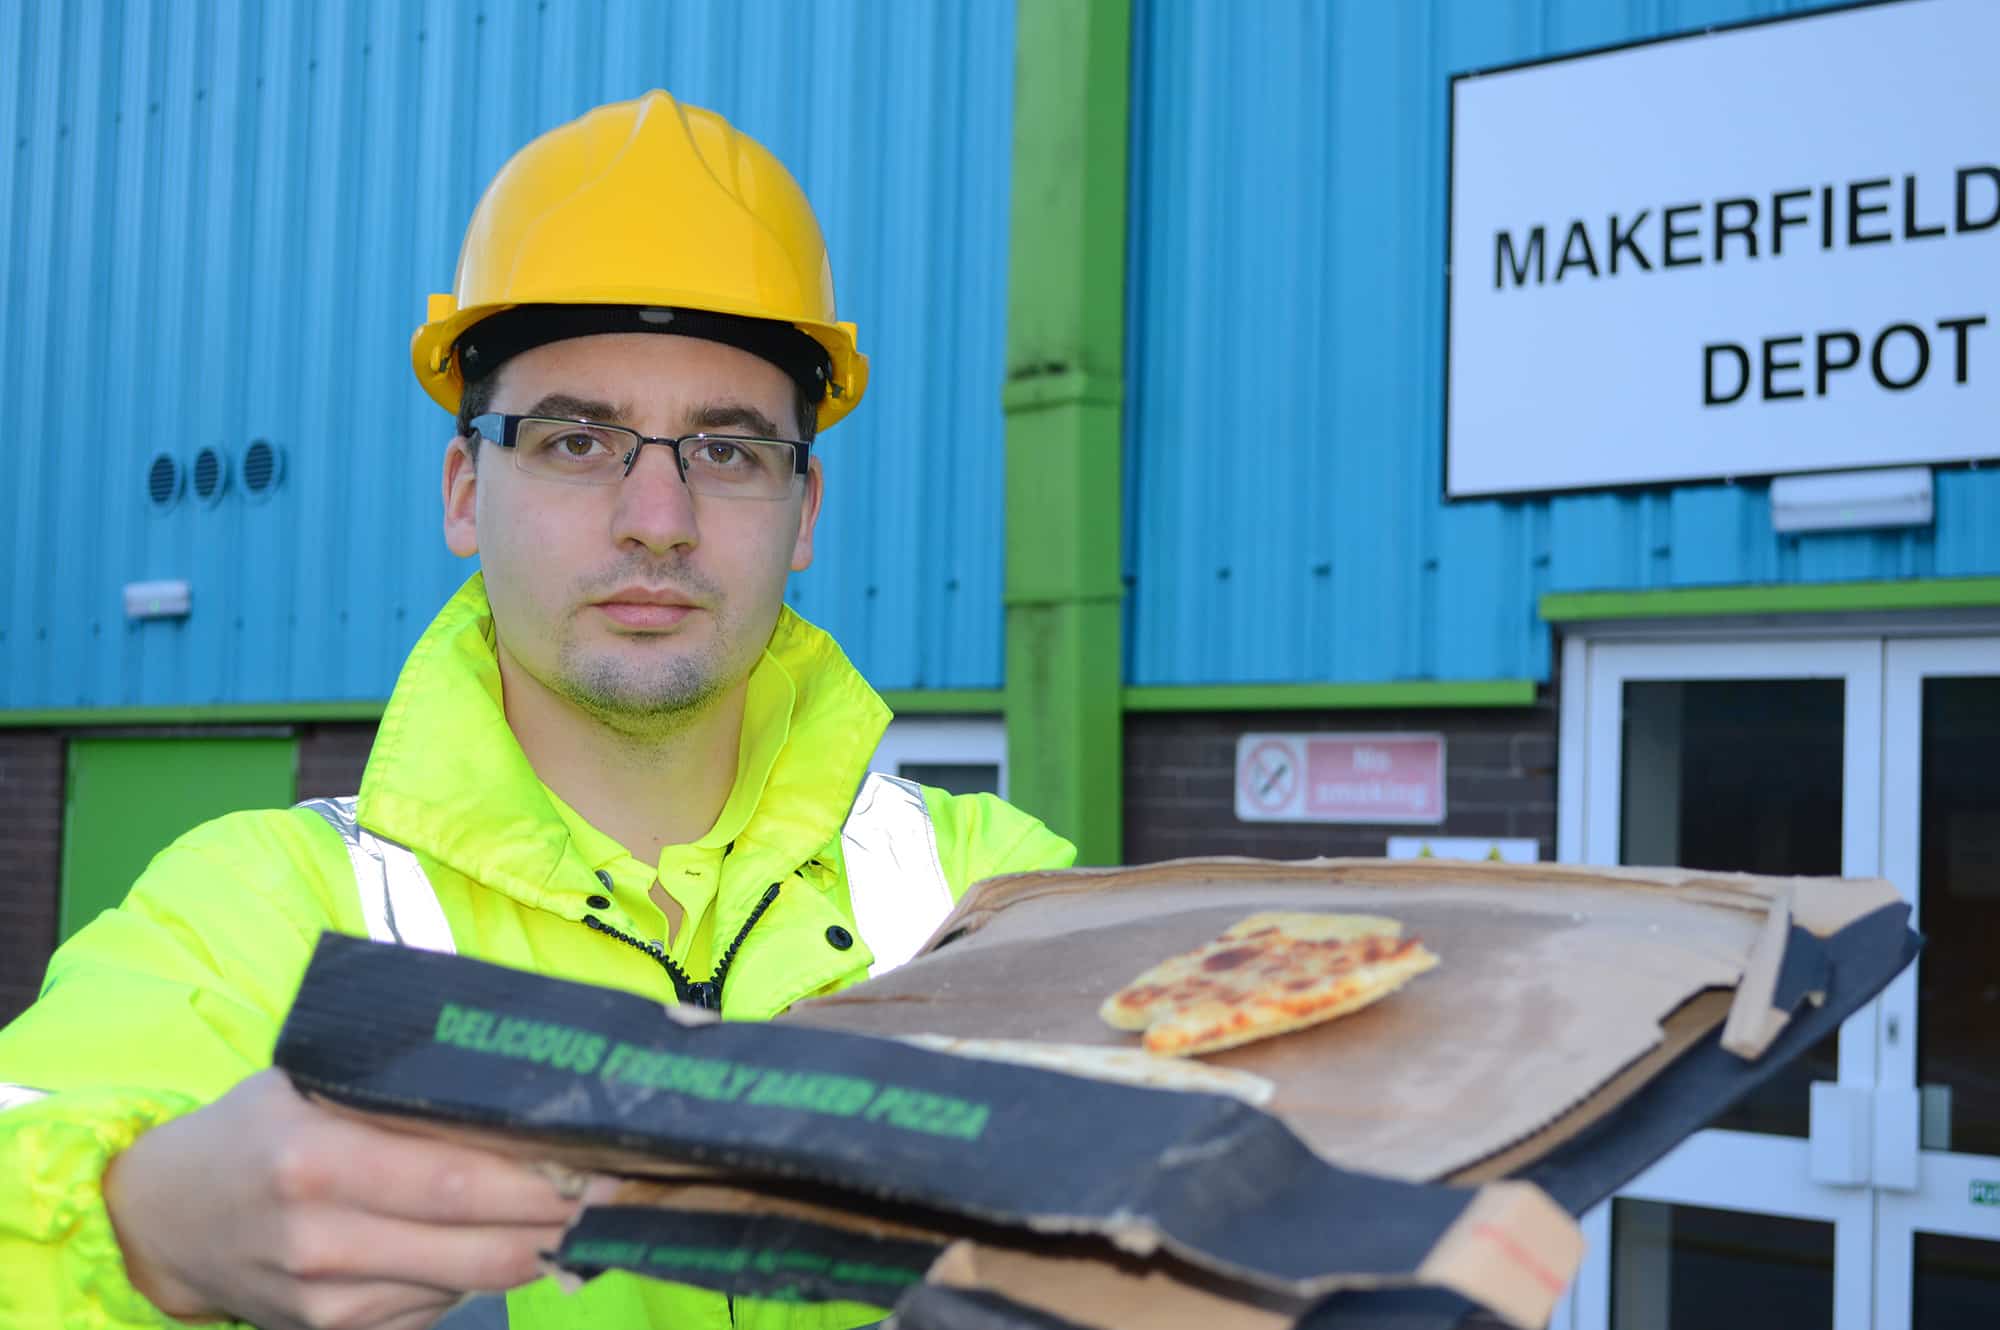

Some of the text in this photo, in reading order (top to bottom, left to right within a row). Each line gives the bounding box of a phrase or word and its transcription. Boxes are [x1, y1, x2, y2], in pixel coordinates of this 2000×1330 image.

[1495, 164, 2000, 290] MAKERFIELD
[1703, 315, 1989, 407] DEPOT
[434, 1003, 608, 1075] DELICIOUS
[863, 1084, 989, 1141] PIZZA
